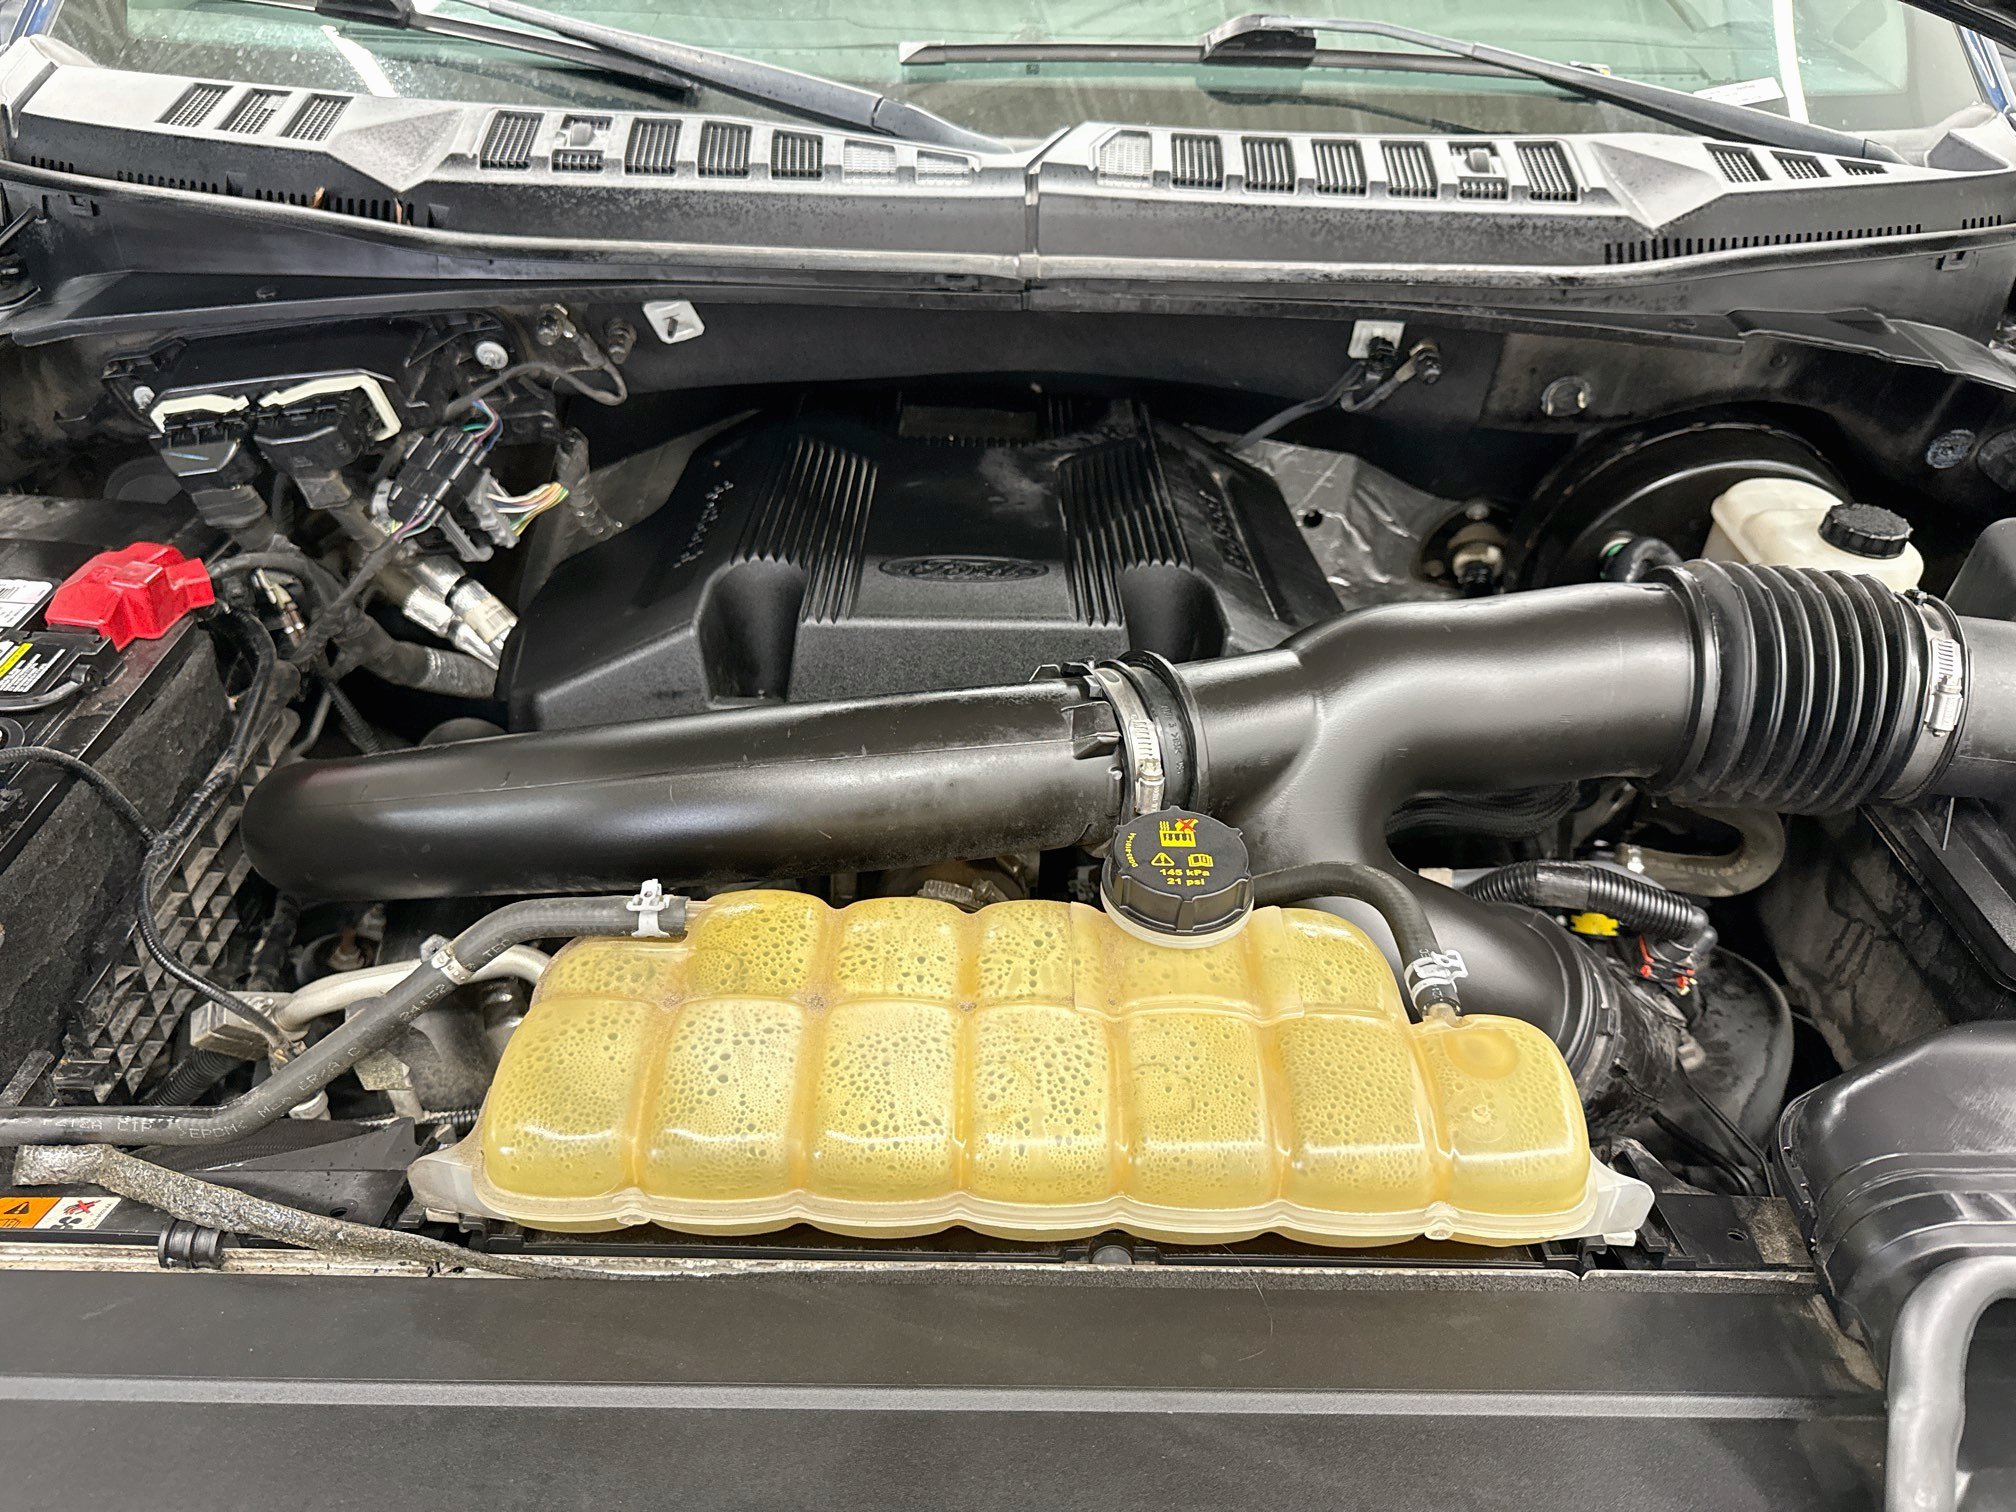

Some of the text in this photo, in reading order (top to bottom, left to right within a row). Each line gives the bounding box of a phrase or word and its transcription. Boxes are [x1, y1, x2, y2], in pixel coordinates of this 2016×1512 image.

[904, 558, 1041, 579] Ford
[1159, 868, 1210, 877] 145 kPa
[1166, 877, 1205, 887] 21 psi
